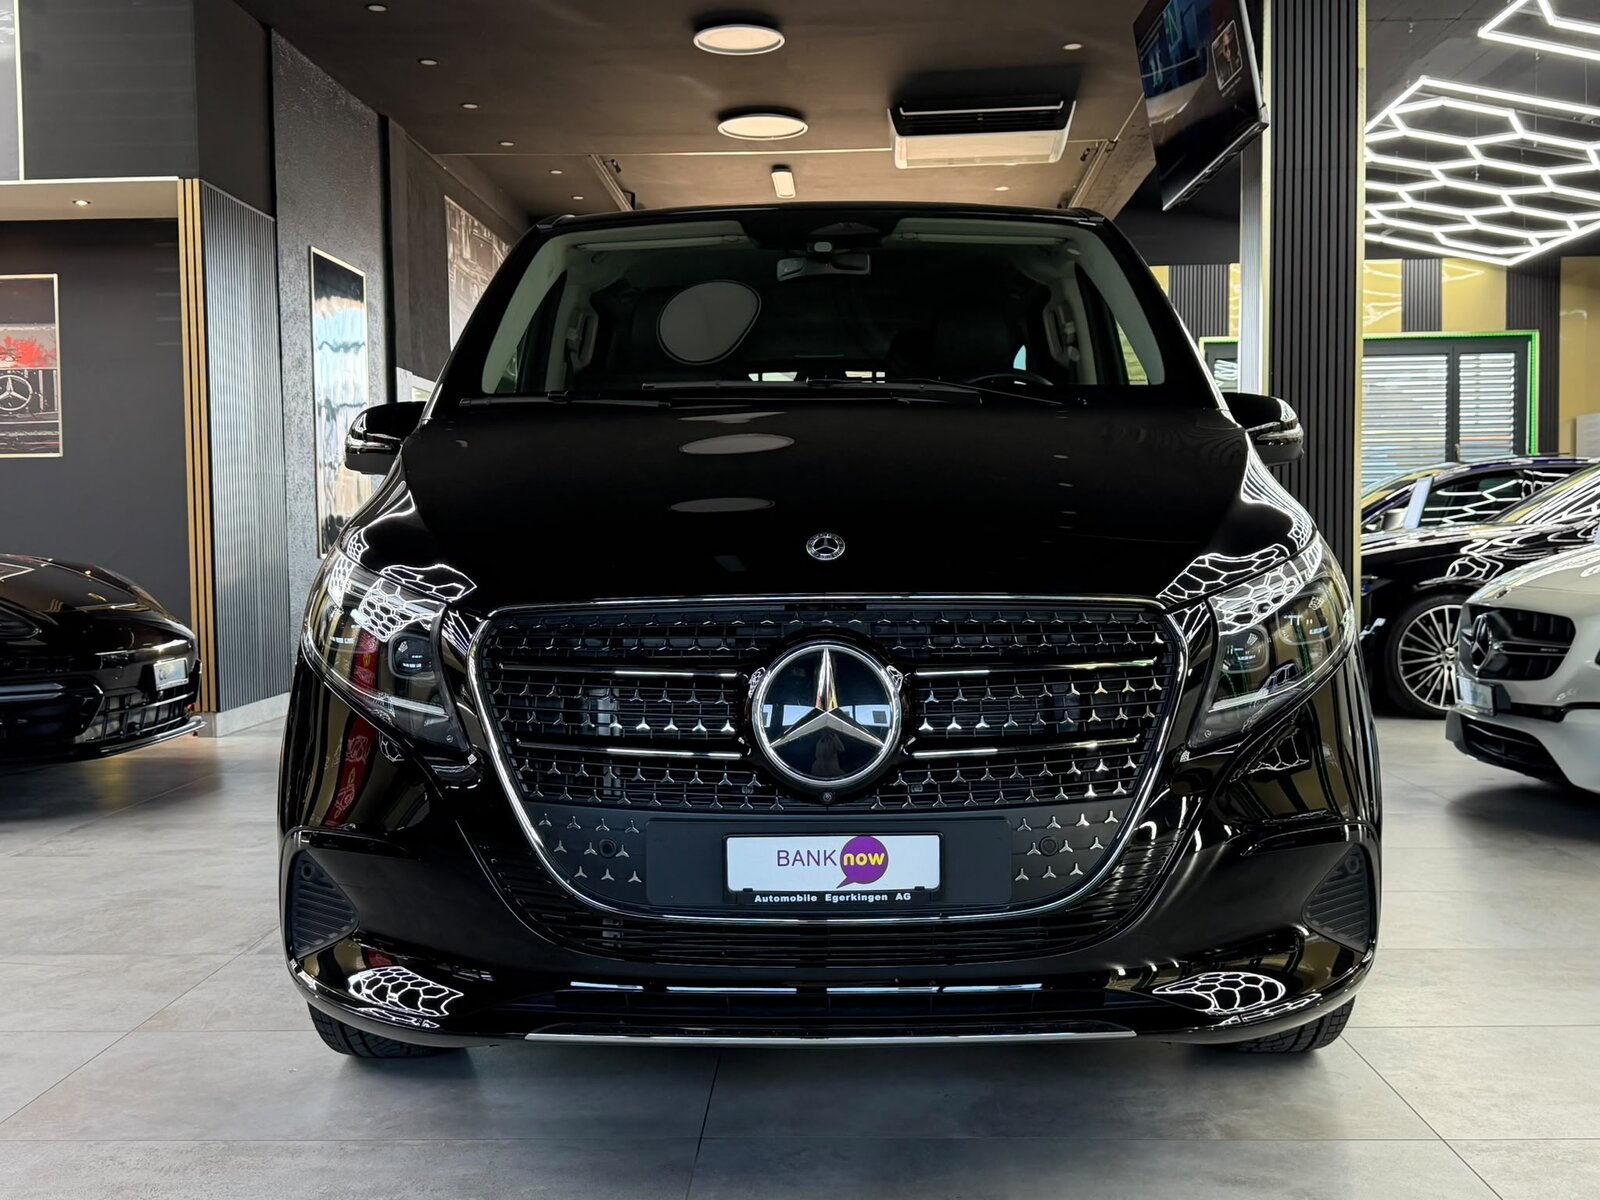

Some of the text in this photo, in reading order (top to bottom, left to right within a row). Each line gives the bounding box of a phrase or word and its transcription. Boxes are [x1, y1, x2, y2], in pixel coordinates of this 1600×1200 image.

[776, 849, 885, 867] BANK now
[754, 892, 912, 904] Automobile Egerkingen AG
